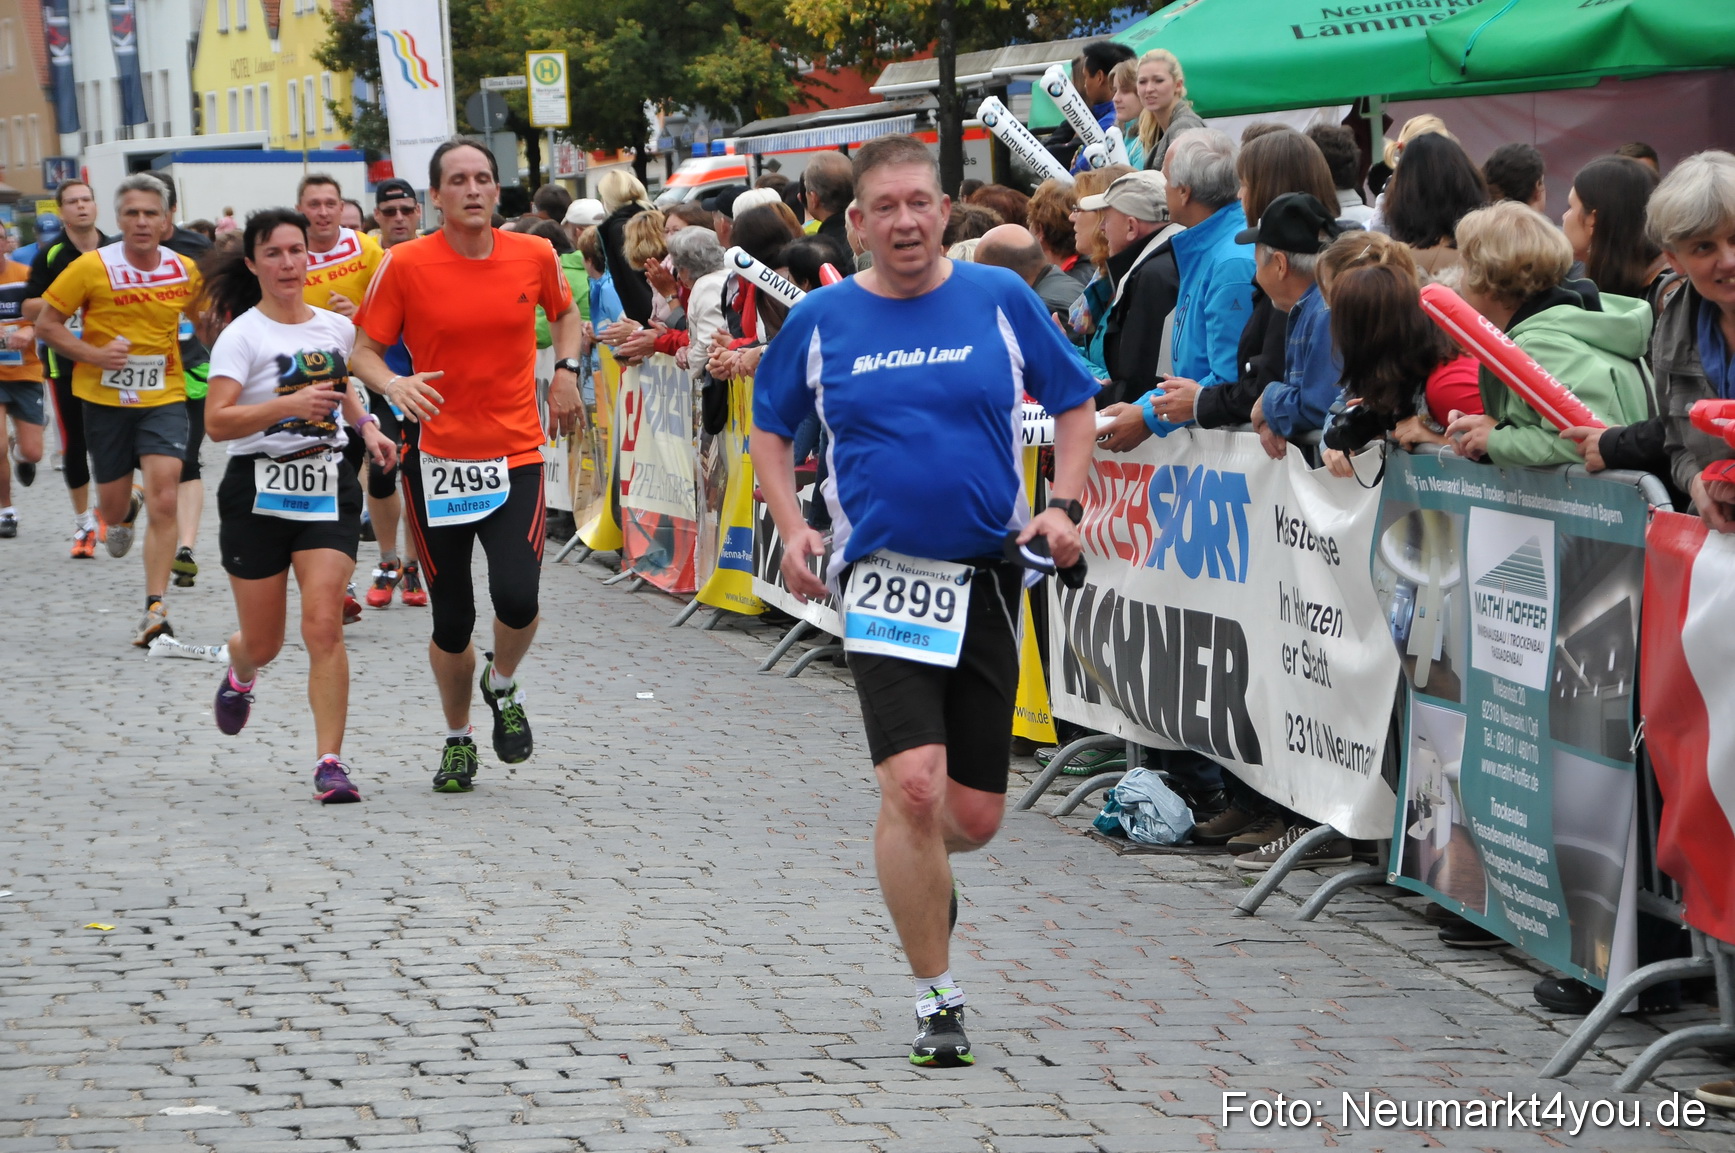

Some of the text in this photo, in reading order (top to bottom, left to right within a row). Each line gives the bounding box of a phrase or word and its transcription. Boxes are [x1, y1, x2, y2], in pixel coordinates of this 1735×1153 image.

[304, 260, 367, 286] AX BÖGL
[758, 267, 801, 301] BMW
[113, 292, 152, 306] MAX
[851, 345, 974, 375] Ski-Club Lauf
[109, 367, 158, 388] 2318
[265, 463, 328, 492] 2061
[432, 465, 501, 495] 2493
[282, 498, 310, 510] Irene
[447, 500, 491, 514] Andreas
[1598, 503, 1624, 527] Bayern
[896, 562, 952, 582] Neumarkt
[855, 571, 956, 623] 2899
[1292, 586, 1343, 638] Herzen
[1505, 598, 1547, 631] HOFFER
[866, 621, 930, 647] Andreas
[1510, 633, 1545, 654] TROCKENBAU
[1481, 700, 1501, 724] 92318
[1490, 796, 1528, 829] Trockenbau
